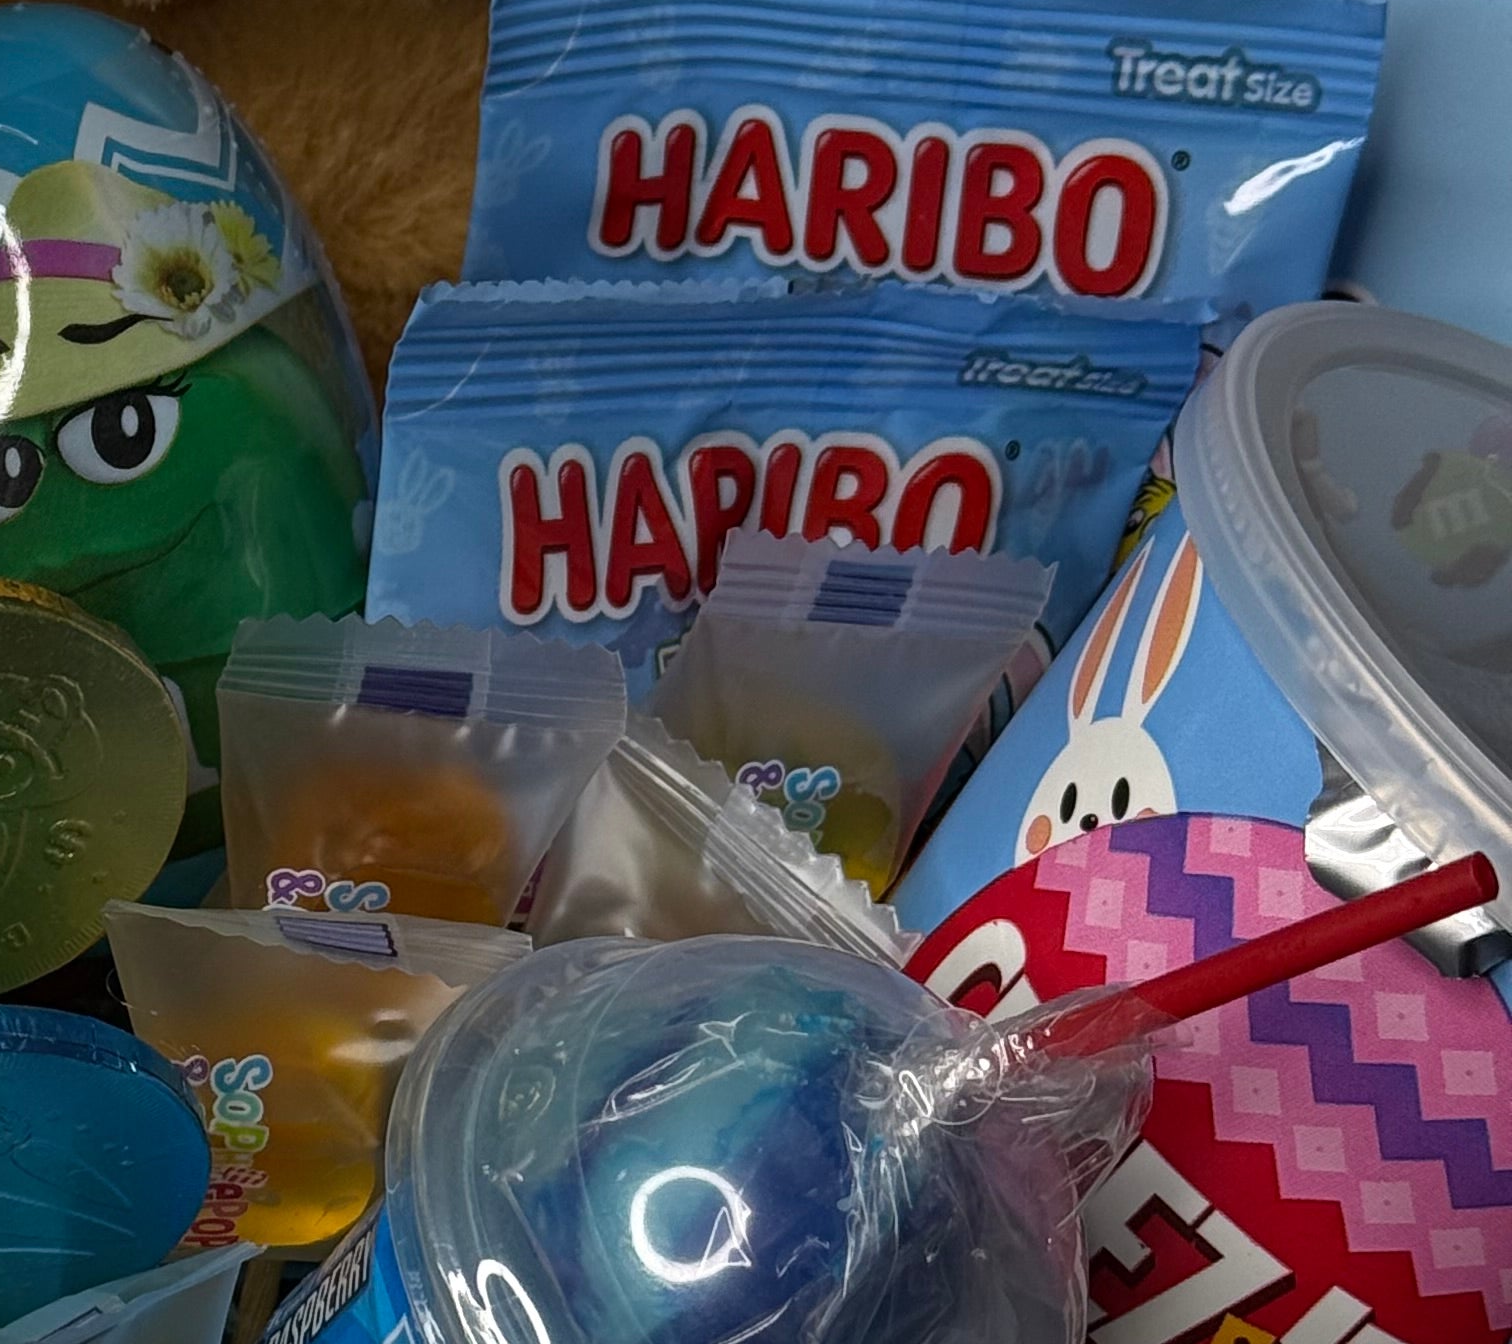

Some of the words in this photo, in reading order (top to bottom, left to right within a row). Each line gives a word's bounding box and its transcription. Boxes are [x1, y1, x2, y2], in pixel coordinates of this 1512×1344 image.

[1111, 45, 1243, 102] Treat
[1243, 69, 1316, 109] Size
[595, 116, 1162, 299] HARIBO
